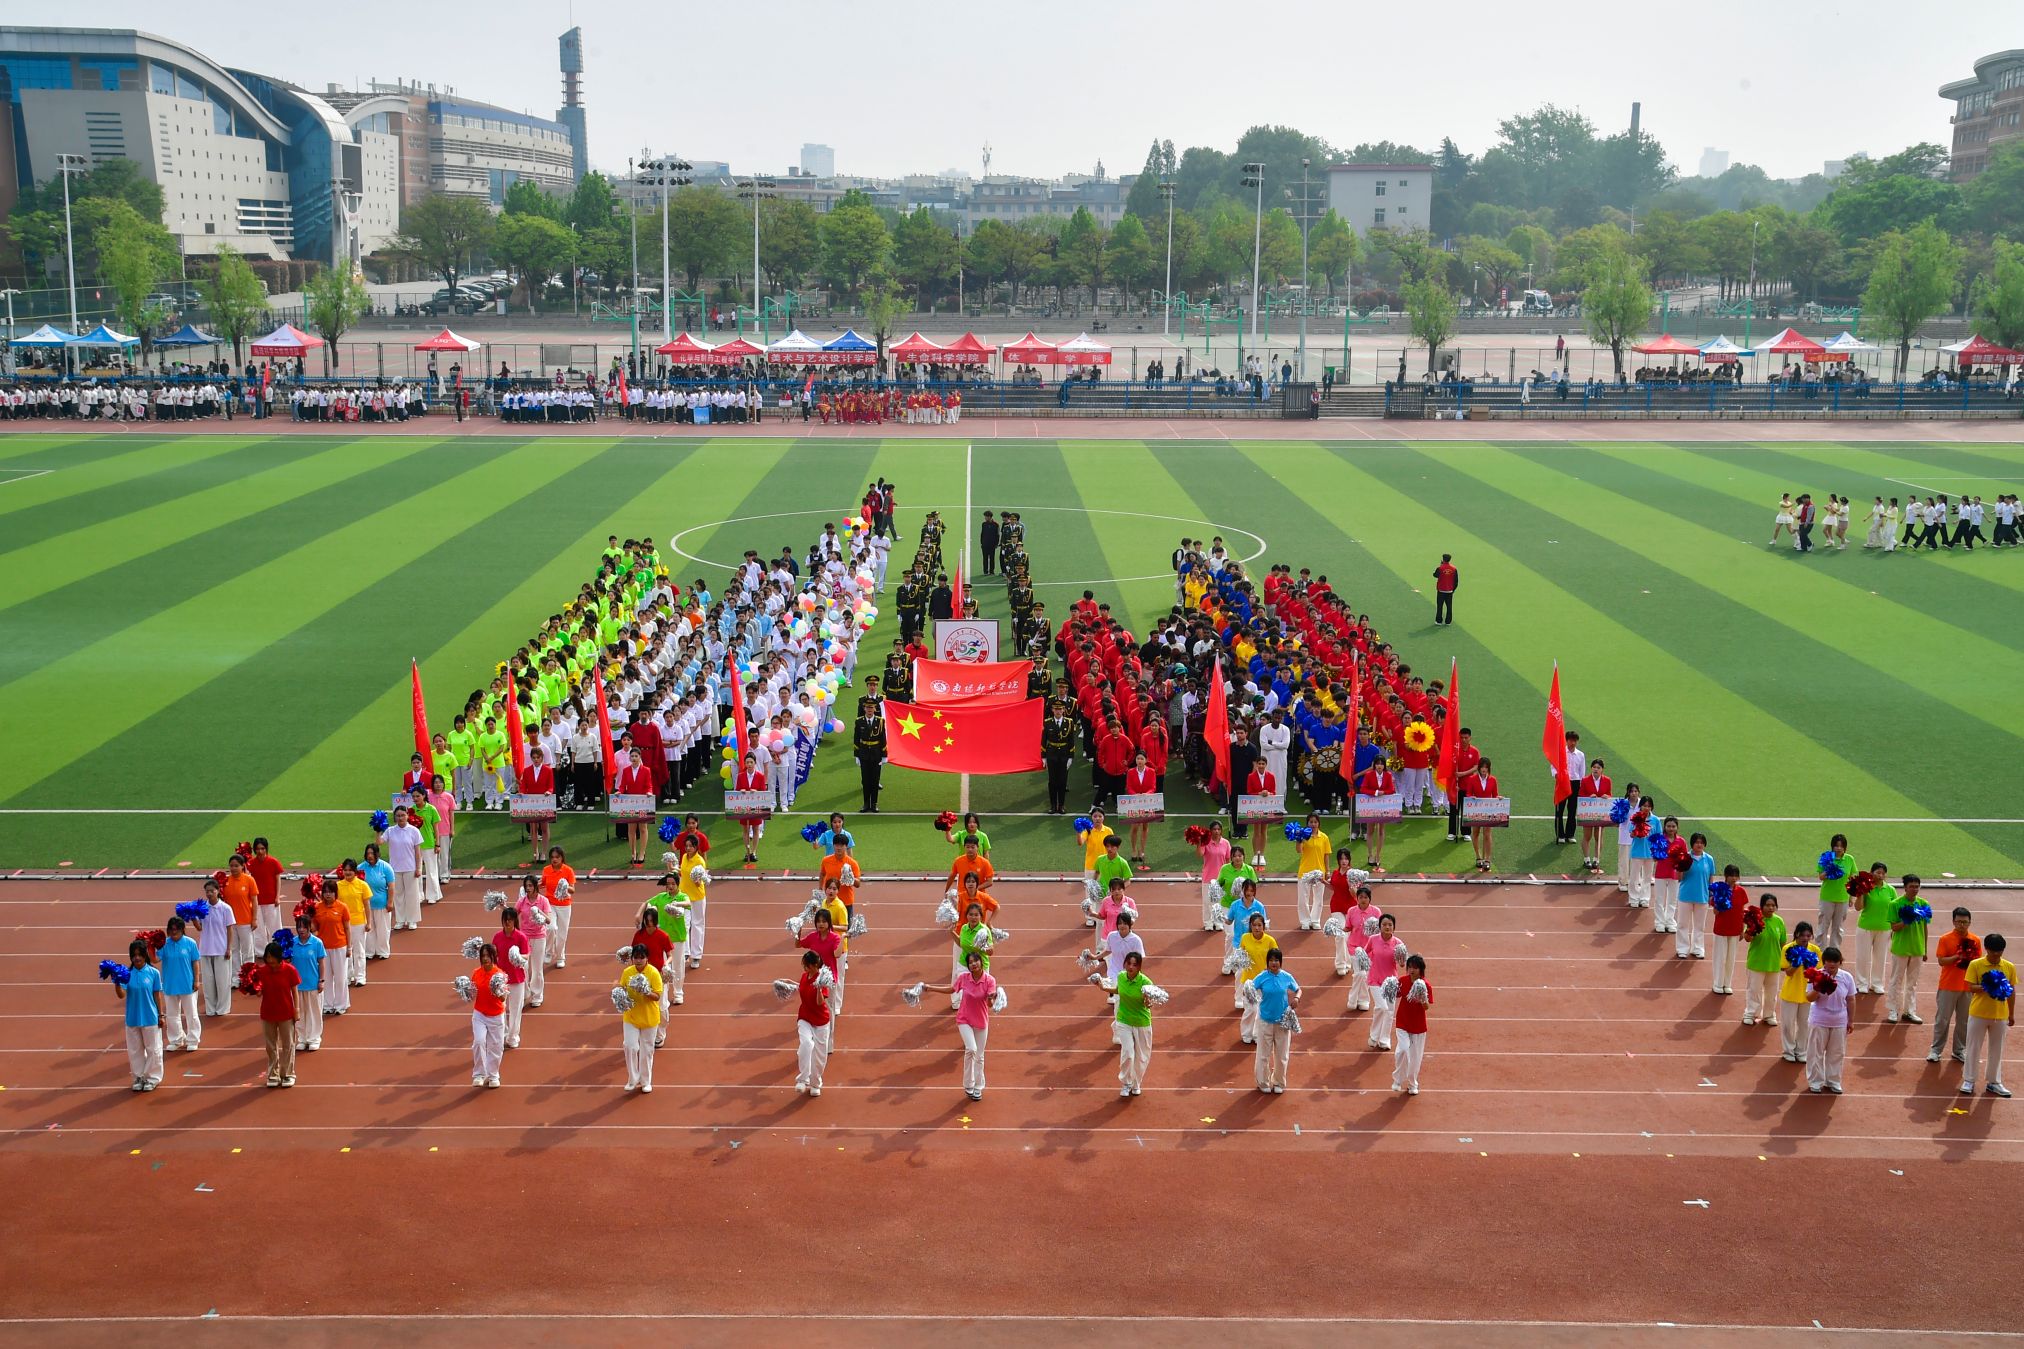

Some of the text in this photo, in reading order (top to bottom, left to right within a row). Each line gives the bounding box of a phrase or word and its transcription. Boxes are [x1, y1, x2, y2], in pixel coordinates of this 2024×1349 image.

[770, 353, 876, 363] 美术与艺术设计学院
[907, 353, 979, 362] 生命科学学院
[951, 640, 967, 653] 45
